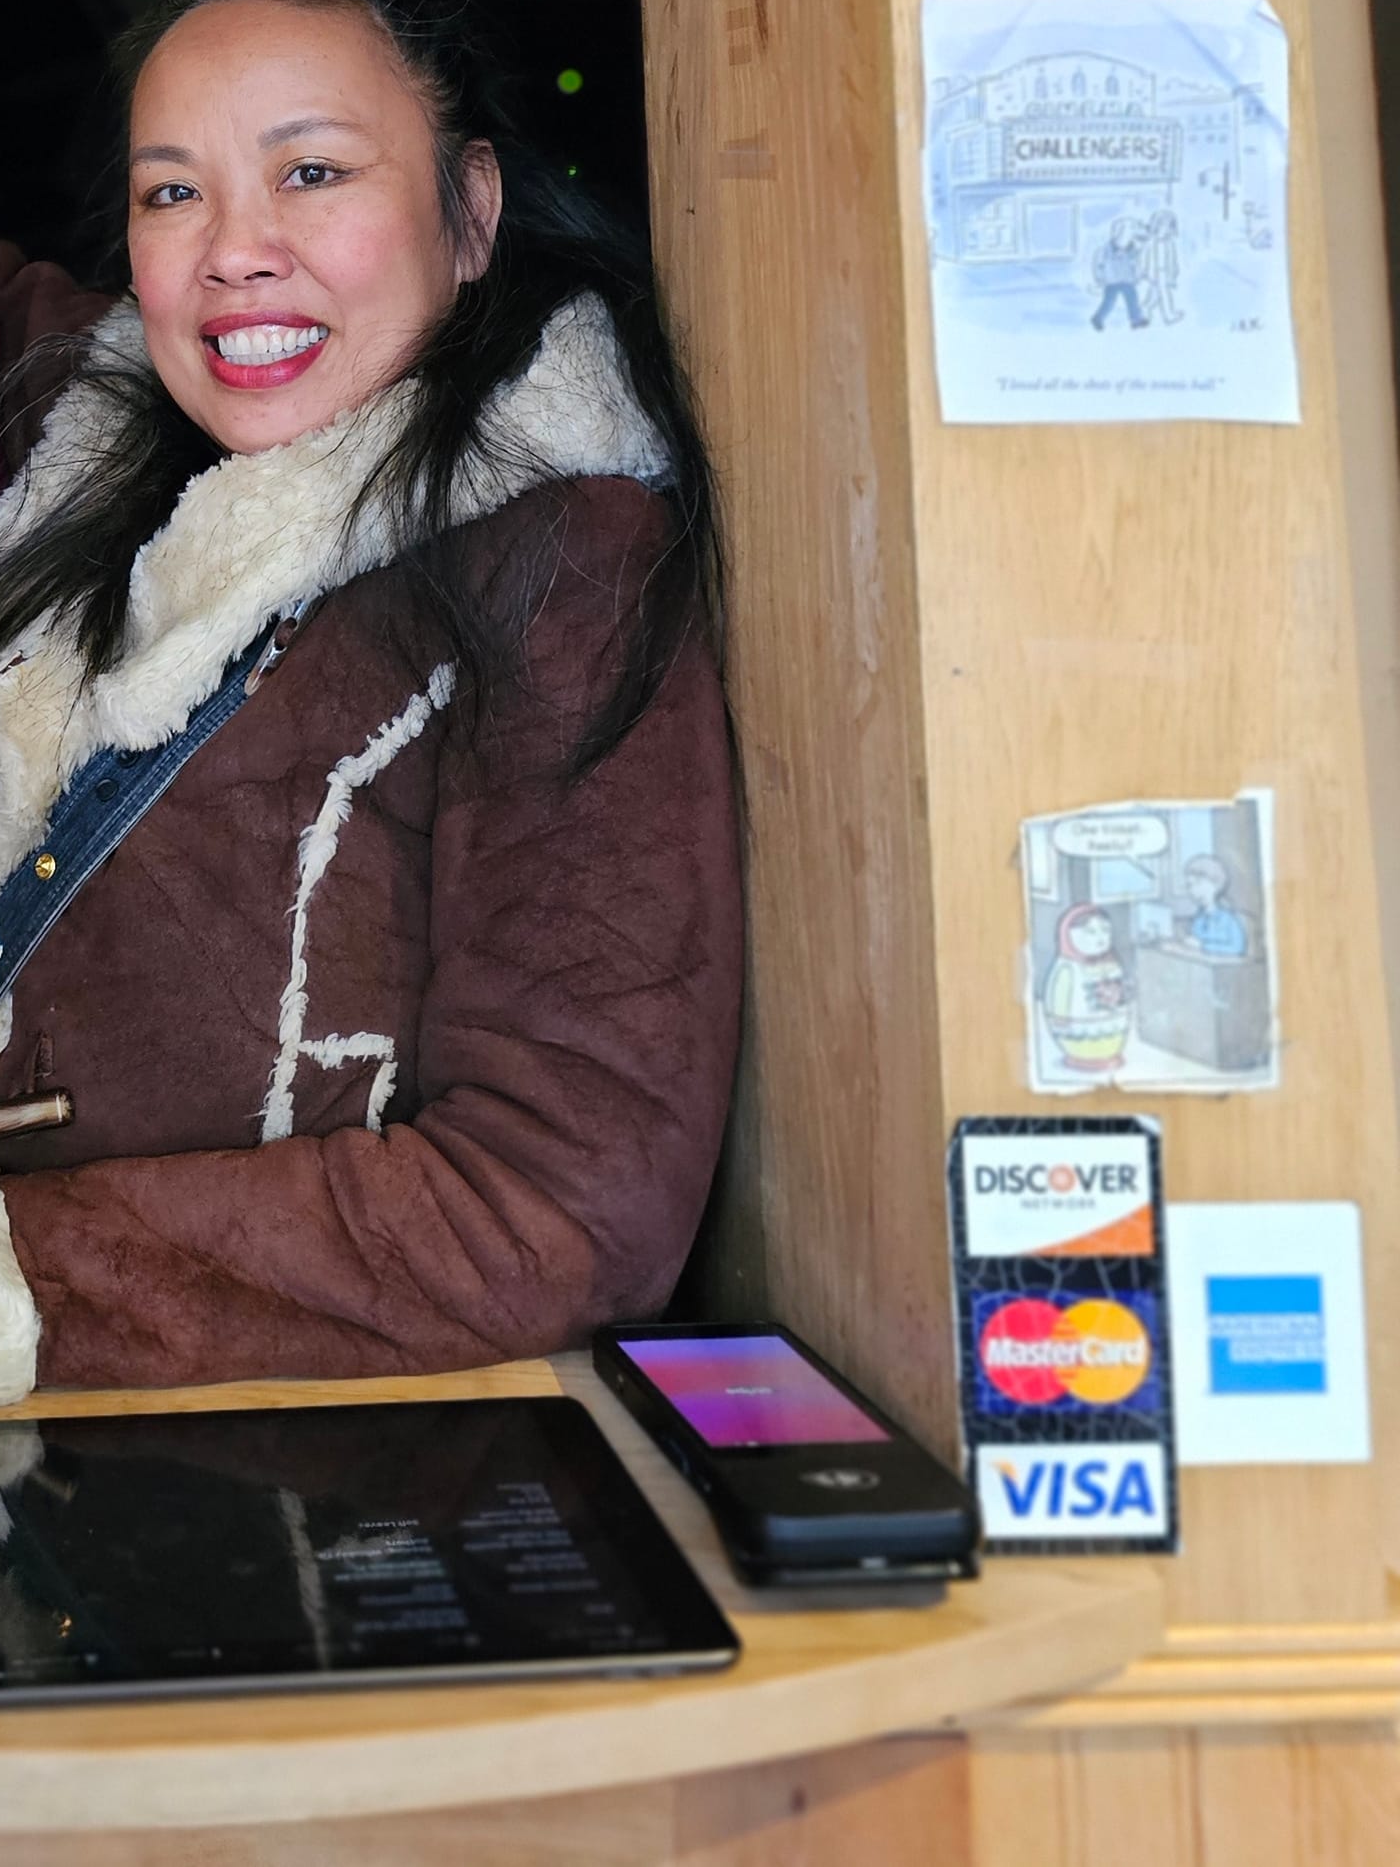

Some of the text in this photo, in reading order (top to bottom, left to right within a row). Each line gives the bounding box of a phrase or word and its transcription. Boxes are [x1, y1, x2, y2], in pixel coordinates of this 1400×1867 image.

[1016, 137, 1159, 161] CHALLENGERS
[975, 1164, 1138, 1194] DISCOVER
[986, 1337, 1146, 1367] MasterCard
[992, 1461, 1155, 1517] VISA
